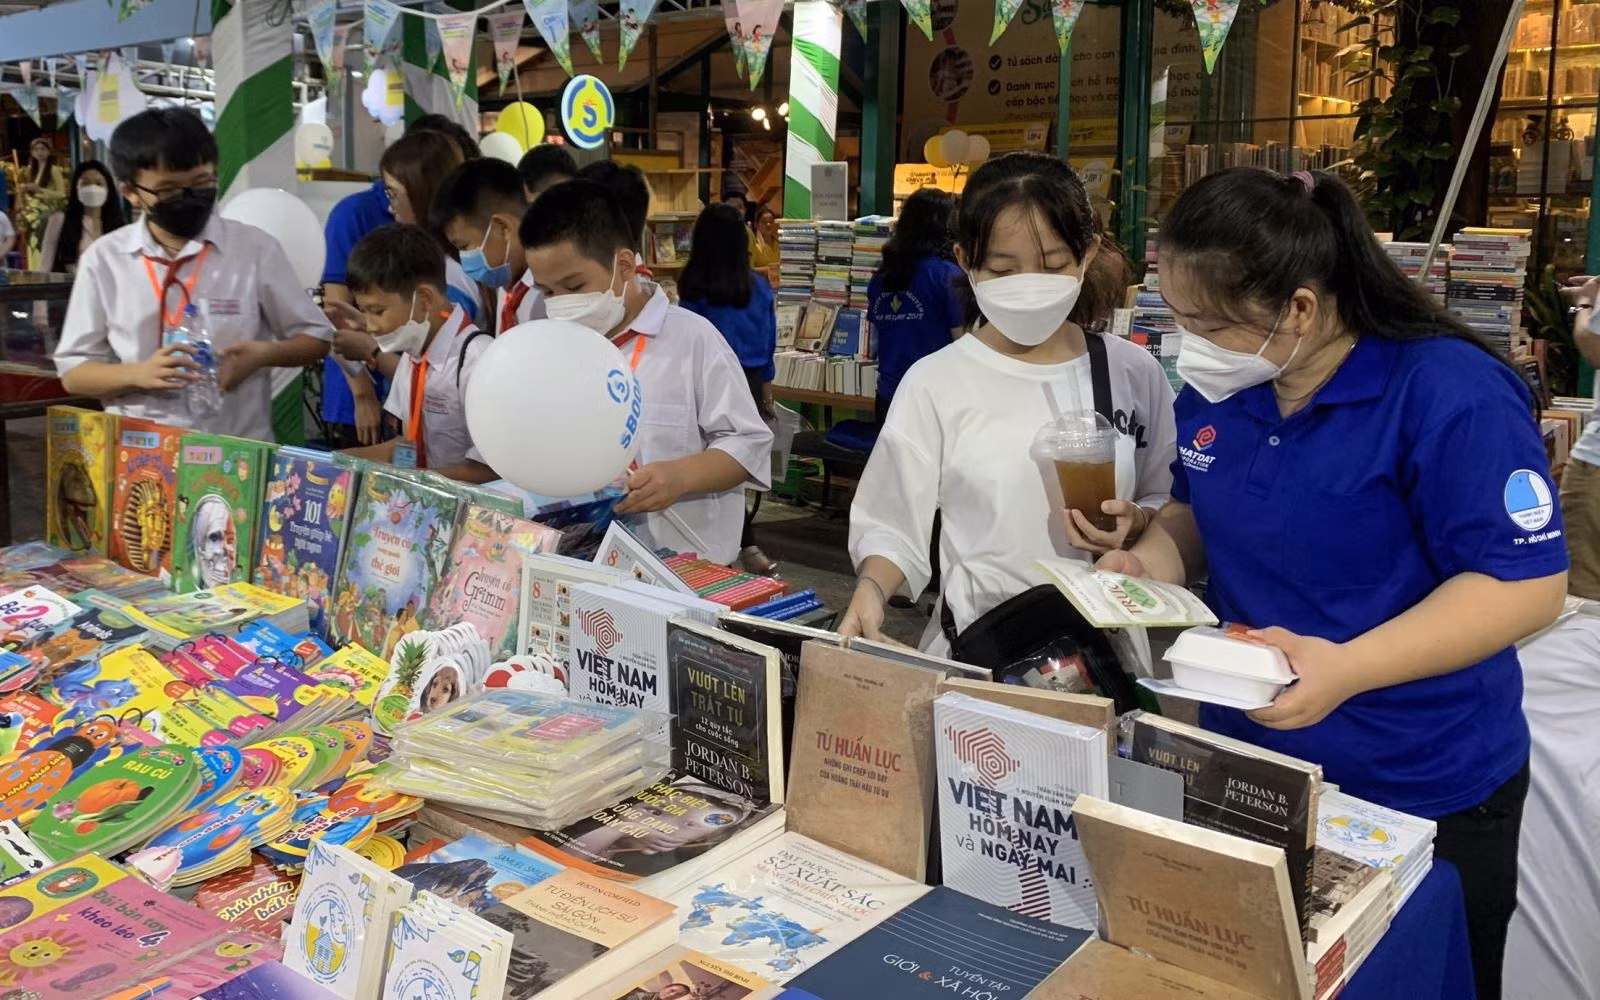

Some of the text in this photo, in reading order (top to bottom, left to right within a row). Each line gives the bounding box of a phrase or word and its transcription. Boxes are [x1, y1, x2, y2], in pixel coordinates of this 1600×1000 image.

[1019, 55, 1042, 66] sách
[1073, 50, 1092, 61] cho
[1006, 81, 1030, 91] Danh
[1034, 80, 1055, 93] mục
[303, 499, 322, 524] 101
[372, 526, 412, 549] Truyện cổ
[1547, 529, 1561, 539] MINH
[371, 557, 401, 576] thế giới
[608, 549, 618, 566] 8
[462, 571, 506, 612] Grimm
[532, 581, 541, 599] 8
[76, 620, 114, 640] Animals
[576, 648, 614, 681] VIỆT
[618, 662, 657, 696] NAM
[688, 667, 746, 704] VƯỢT LÊN
[620, 688, 645, 709] NAY
[691, 691, 743, 727] TRẬT TỰ
[695, 723, 739, 748] cho cuộc sống
[701, 716, 733, 736] 12 quy tắc
[684, 740, 753, 782] JORDAN B.
[816, 728, 901, 773] TỪ HUẤN LỤC
[30, 765, 50, 782] khéo
[50, 753, 66, 767] tay
[121, 760, 174, 780] RAU CỦ
[685, 757, 754, 799] PETERSON
[634, 788, 688, 817] UỐC GIA
[679, 794, 712, 810] BIỆT
[1225, 777, 1289, 806] JORDAN B.
[1225, 788, 1289, 817] PETERSON
[592, 810, 621, 828] OÀN
[612, 801, 642, 823] ỒNG
[947, 776, 1078, 841] VIỆT NAM
[298, 816, 328, 836] ong
[969, 812, 1059, 857] HÔM NAY
[178, 833, 203, 849] con
[955, 834, 1076, 885] và NGÀY MAI
[247, 881, 294, 909] nhím
[576, 881, 641, 907] JUSTIN CORFIELD
[755, 864, 786, 881] MANG
[809, 885, 840, 907] CHIẾN
[764, 856, 796, 870] SỰ
[790, 867, 846, 892] XUẤT
[842, 889, 885, 911] SẮC
[91, 889, 169, 933] Đôi bàn tay
[256, 897, 287, 920] bất
[551, 901, 572, 915] SÀI
[572, 909, 601, 924] GÒN
[560, 891, 589, 907] ĐIỂN
[588, 902, 617, 916] LỊCH
[616, 912, 639, 923] SỬ
[77, 907, 170, 948] khéo léo 4
[1154, 906, 1210, 936] HUẤN
[1213, 926, 1256, 950] LỤC
[700, 960, 722, 972] NGUYỄN
[883, 954, 920, 973] GIỚI
[918, 971, 933, 981] &
[934, 975, 963, 992] XÃ
[949, 965, 1011, 992] TUYỂN TẬP
